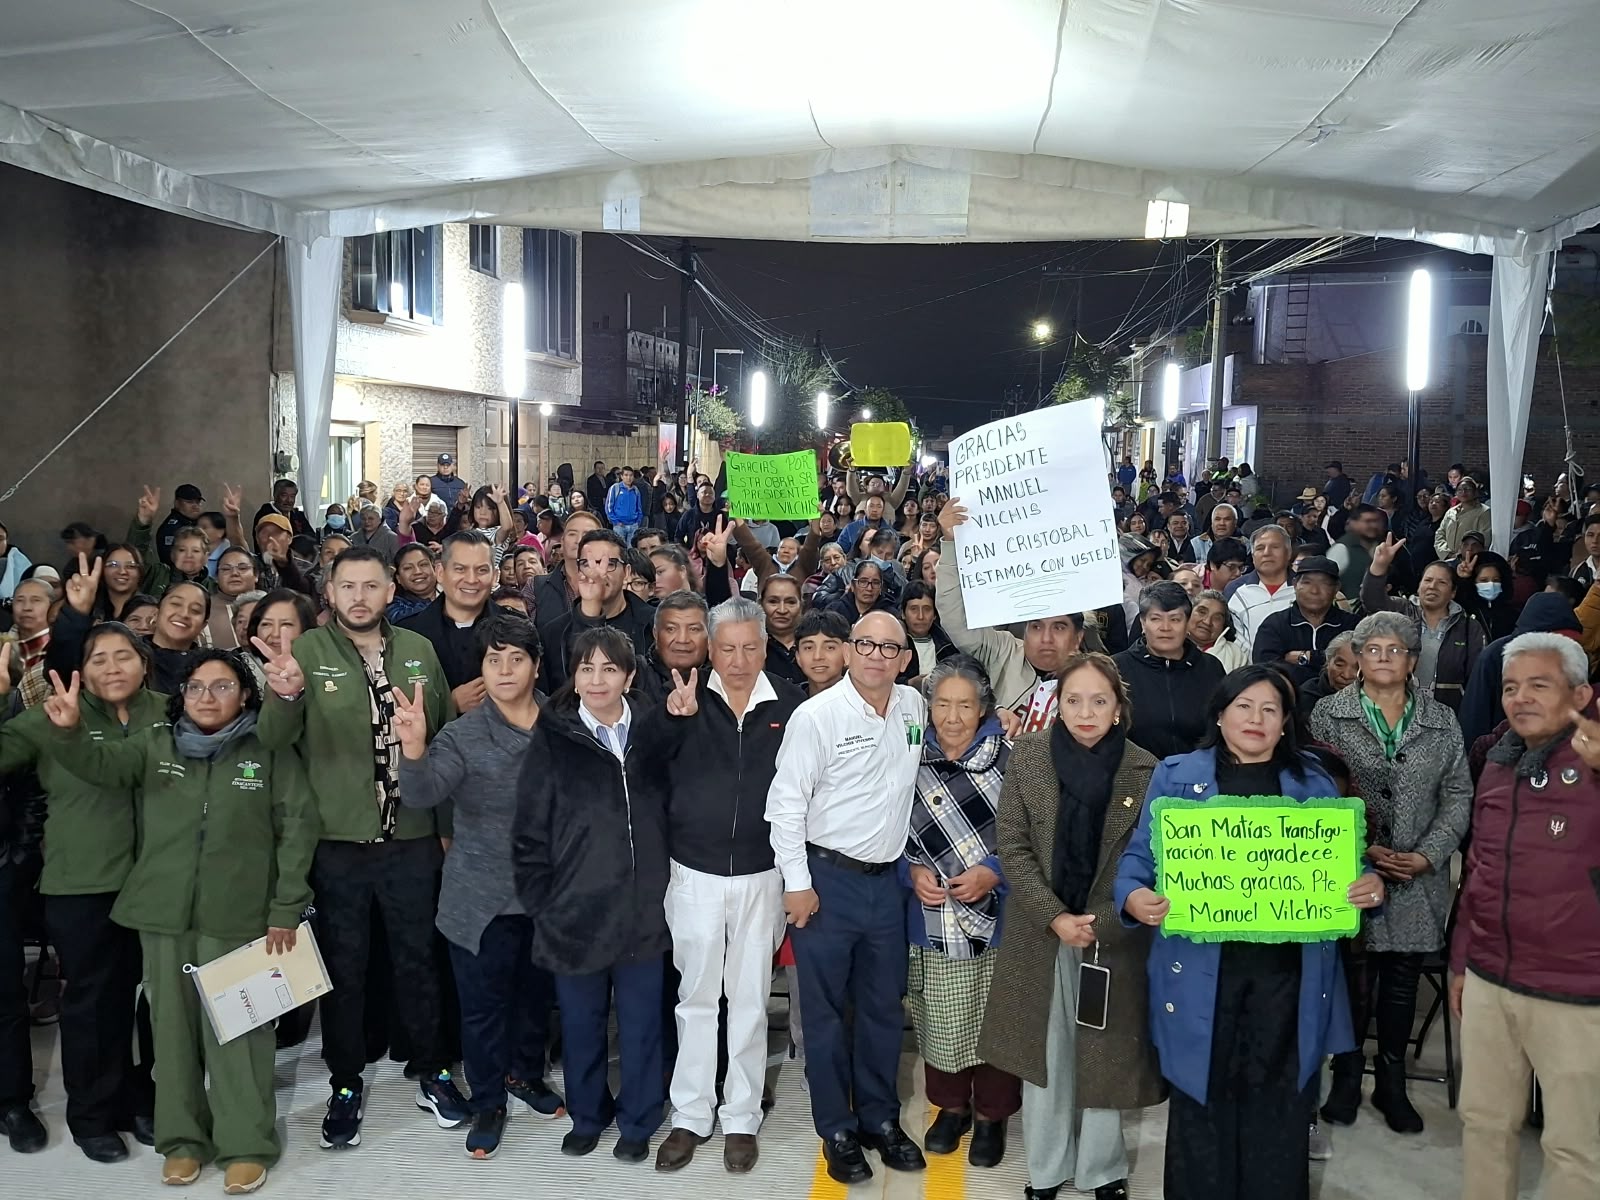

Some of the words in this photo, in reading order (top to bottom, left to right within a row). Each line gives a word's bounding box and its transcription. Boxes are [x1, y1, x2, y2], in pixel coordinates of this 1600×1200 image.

[955, 421, 1027, 466] GRACIAS
[731, 453, 777, 474] GRACIAS
[786, 454, 812, 471] POR
[955, 447, 1049, 489] PRESIDENTE
[765, 475, 795, 488] OBRA
[978, 477, 1048, 506] MANUEL
[742, 486, 811, 500] PRESIDENTE
[778, 497, 819, 515] VILCHIS
[971, 502, 1041, 529] VILCHIS
[964, 542, 996, 565] SAN
[1006, 523, 1094, 553] CRISTOBAL
[1100, 518, 1112, 533] T
[1041, 556, 1065, 573] CON
[1163, 815, 1202, 840] San
[1211, 815, 1272, 840] Matías
[1276, 815, 1348, 843] Transfigu-
[1221, 846, 1237, 861] le
[1165, 871, 1235, 891] Muchas
[1189, 902, 1258, 923] Manuel
[1269, 899, 1333, 921] Vilchis
